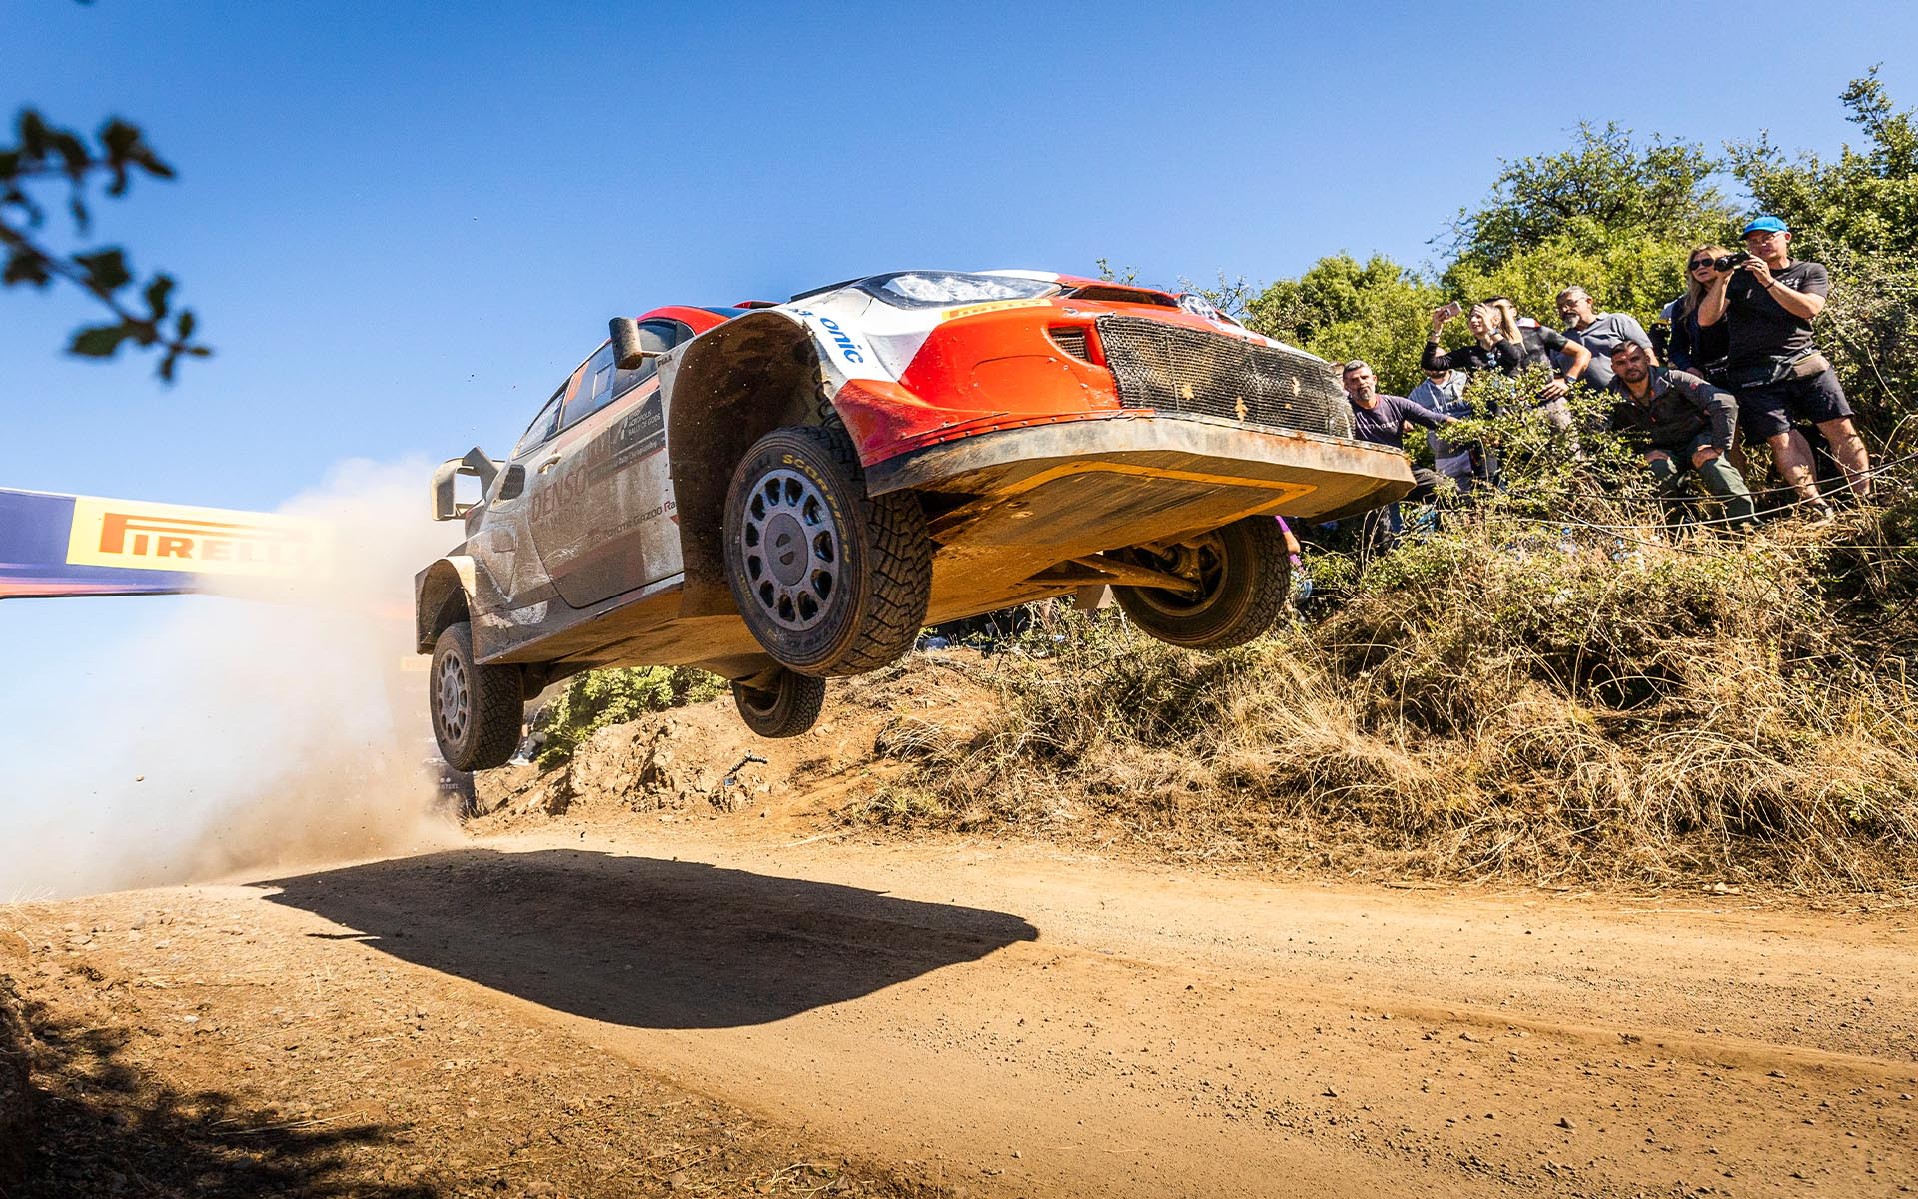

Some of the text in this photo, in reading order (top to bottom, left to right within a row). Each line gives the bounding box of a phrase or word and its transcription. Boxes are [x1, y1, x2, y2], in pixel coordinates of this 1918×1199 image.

[657, 355, 673, 367] PIAA
[533, 465, 586, 522] DENSO
[634, 506, 662, 525] GAZOO
[99, 512, 304, 562] PIRELL
